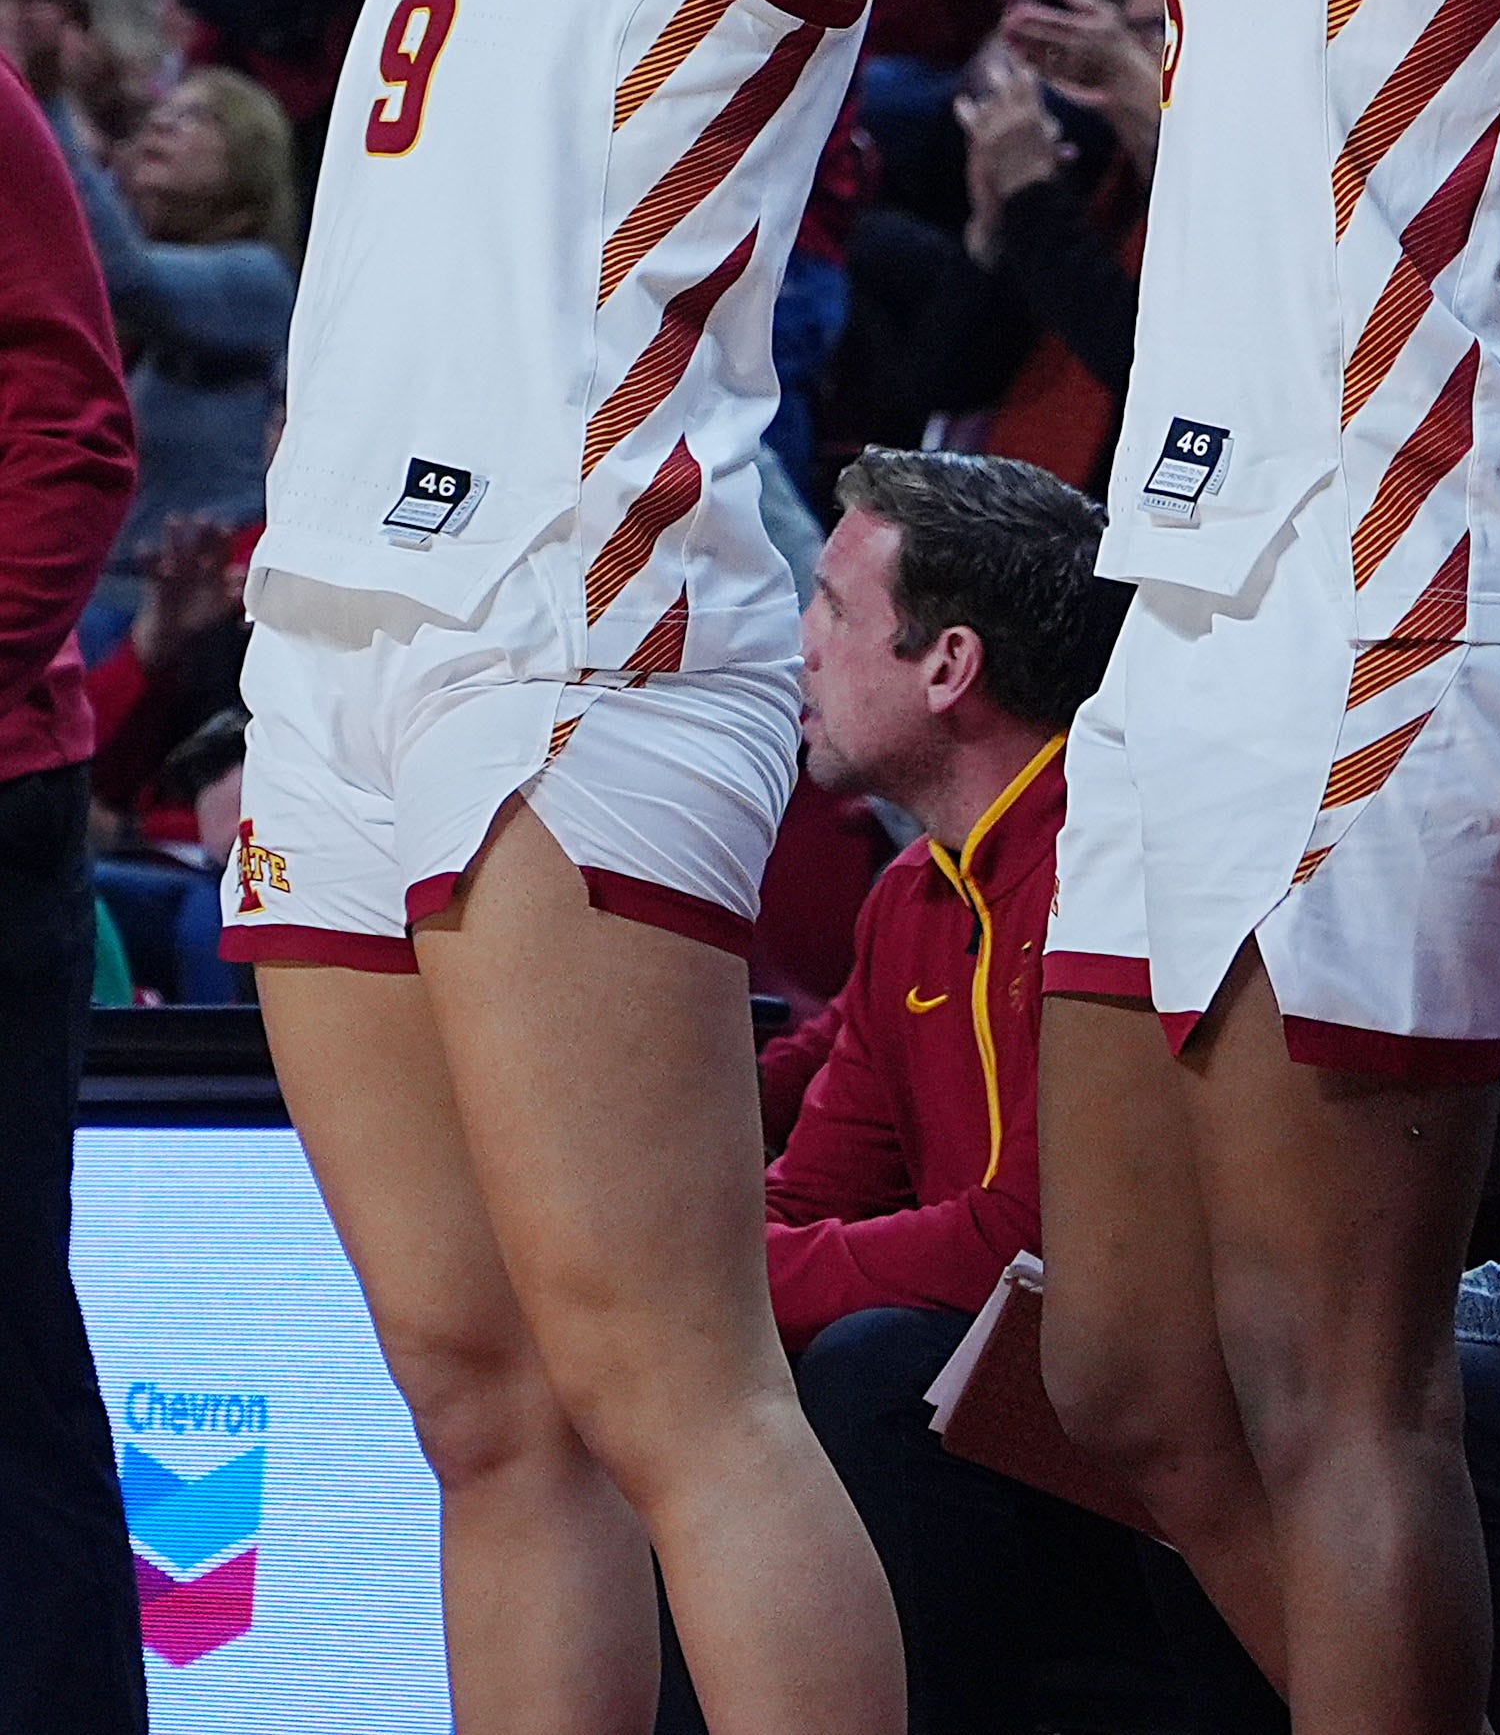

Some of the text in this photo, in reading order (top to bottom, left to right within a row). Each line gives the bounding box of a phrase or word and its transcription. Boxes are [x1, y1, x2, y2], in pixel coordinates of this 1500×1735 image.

[1176, 430, 1211, 457] 46
[418, 471, 457, 497] 46
[124, 1381, 269, 1436] Chevron
